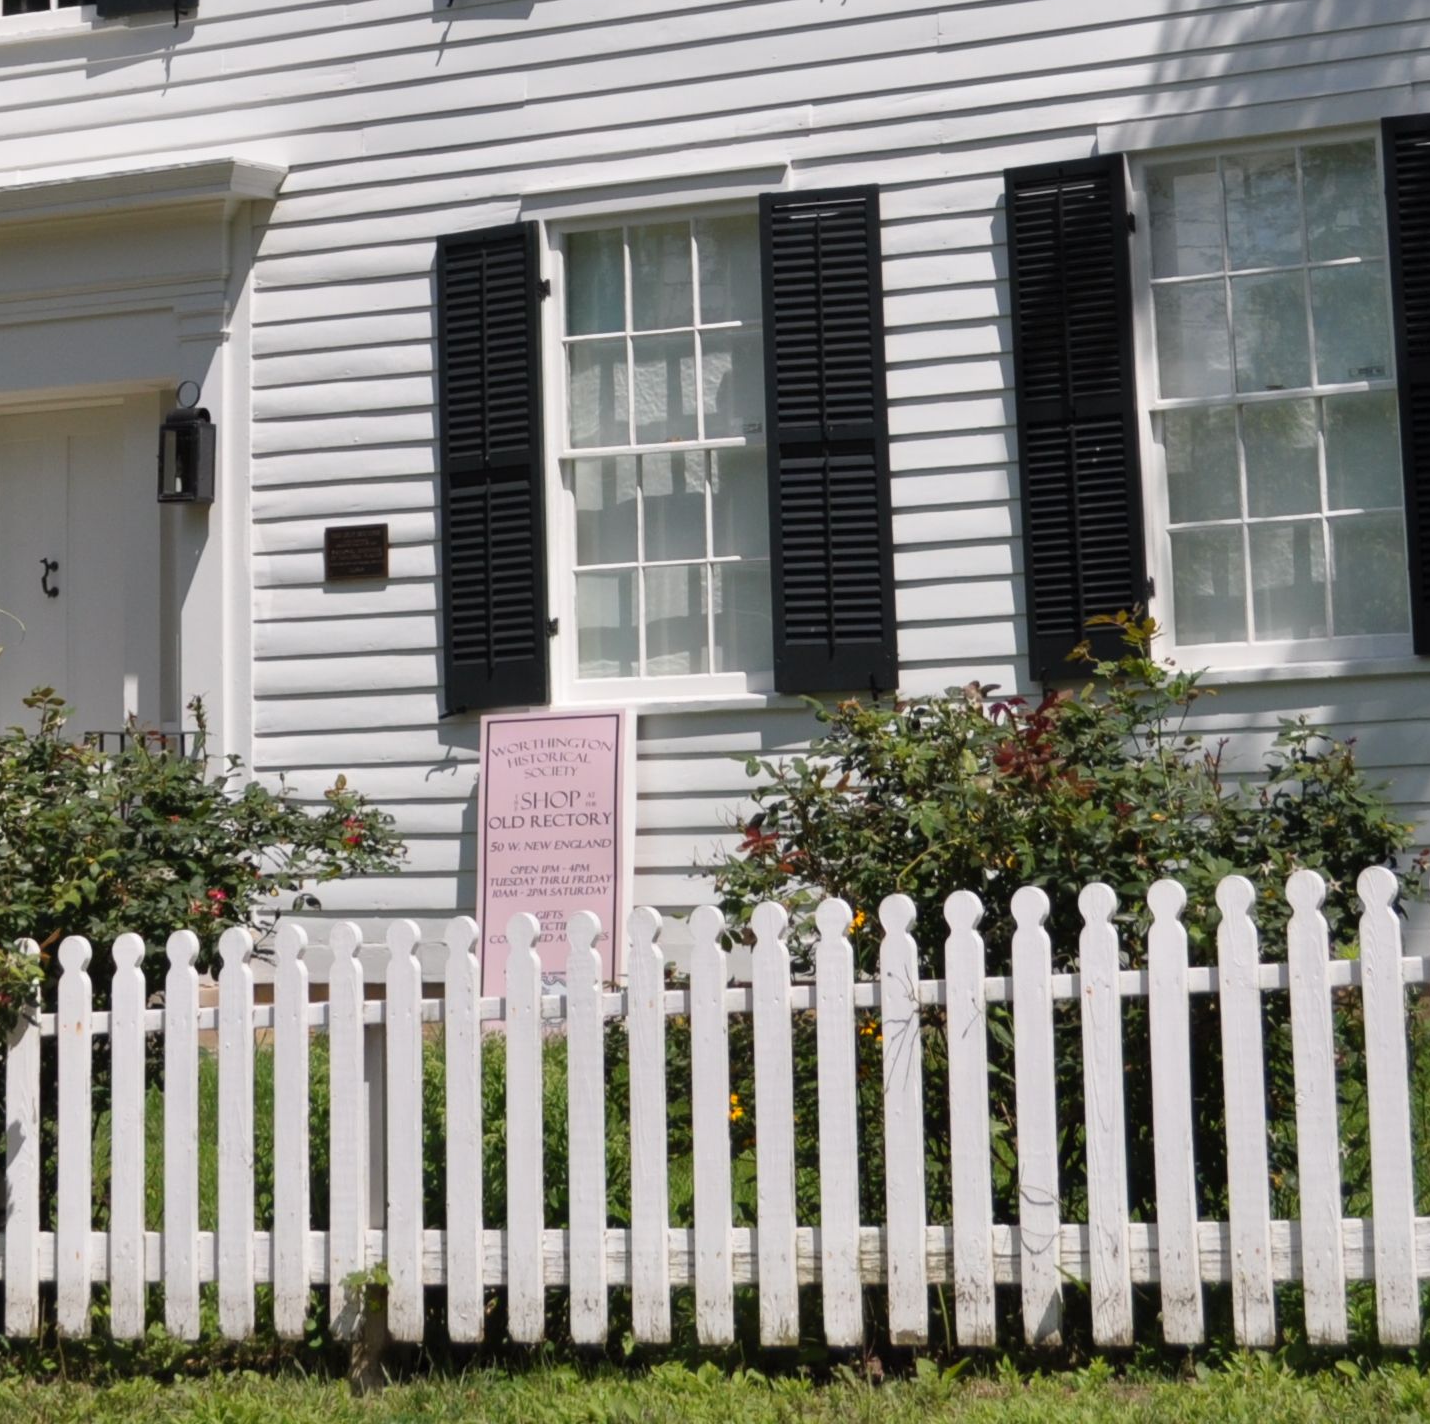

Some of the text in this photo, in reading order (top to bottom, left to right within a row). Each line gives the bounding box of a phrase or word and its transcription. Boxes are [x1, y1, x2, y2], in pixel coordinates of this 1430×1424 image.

[491, 738, 612, 757] WORTHINGTON
[507, 752, 590, 769] HISTORICAL
[524, 765, 578, 779] SOCIETY
[521, 790, 581, 811] SHOP
[488, 812, 612, 830] OLD RECTORY
[490, 841, 505, 853] 50
[524, 841, 551, 851] NEW
[554, 838, 612, 850] ENGLAND
[510, 865, 539, 875] OPEN
[569, 863, 590, 873] 4PM
[490, 874, 612, 887] TUESDAY THRU FRIDAY
[491, 889, 518, 899] 10AM
[526, 888, 547, 897] 2PM
[550, 886, 609, 897] SATURDAY
[535, 910, 564, 920] GIFTS
